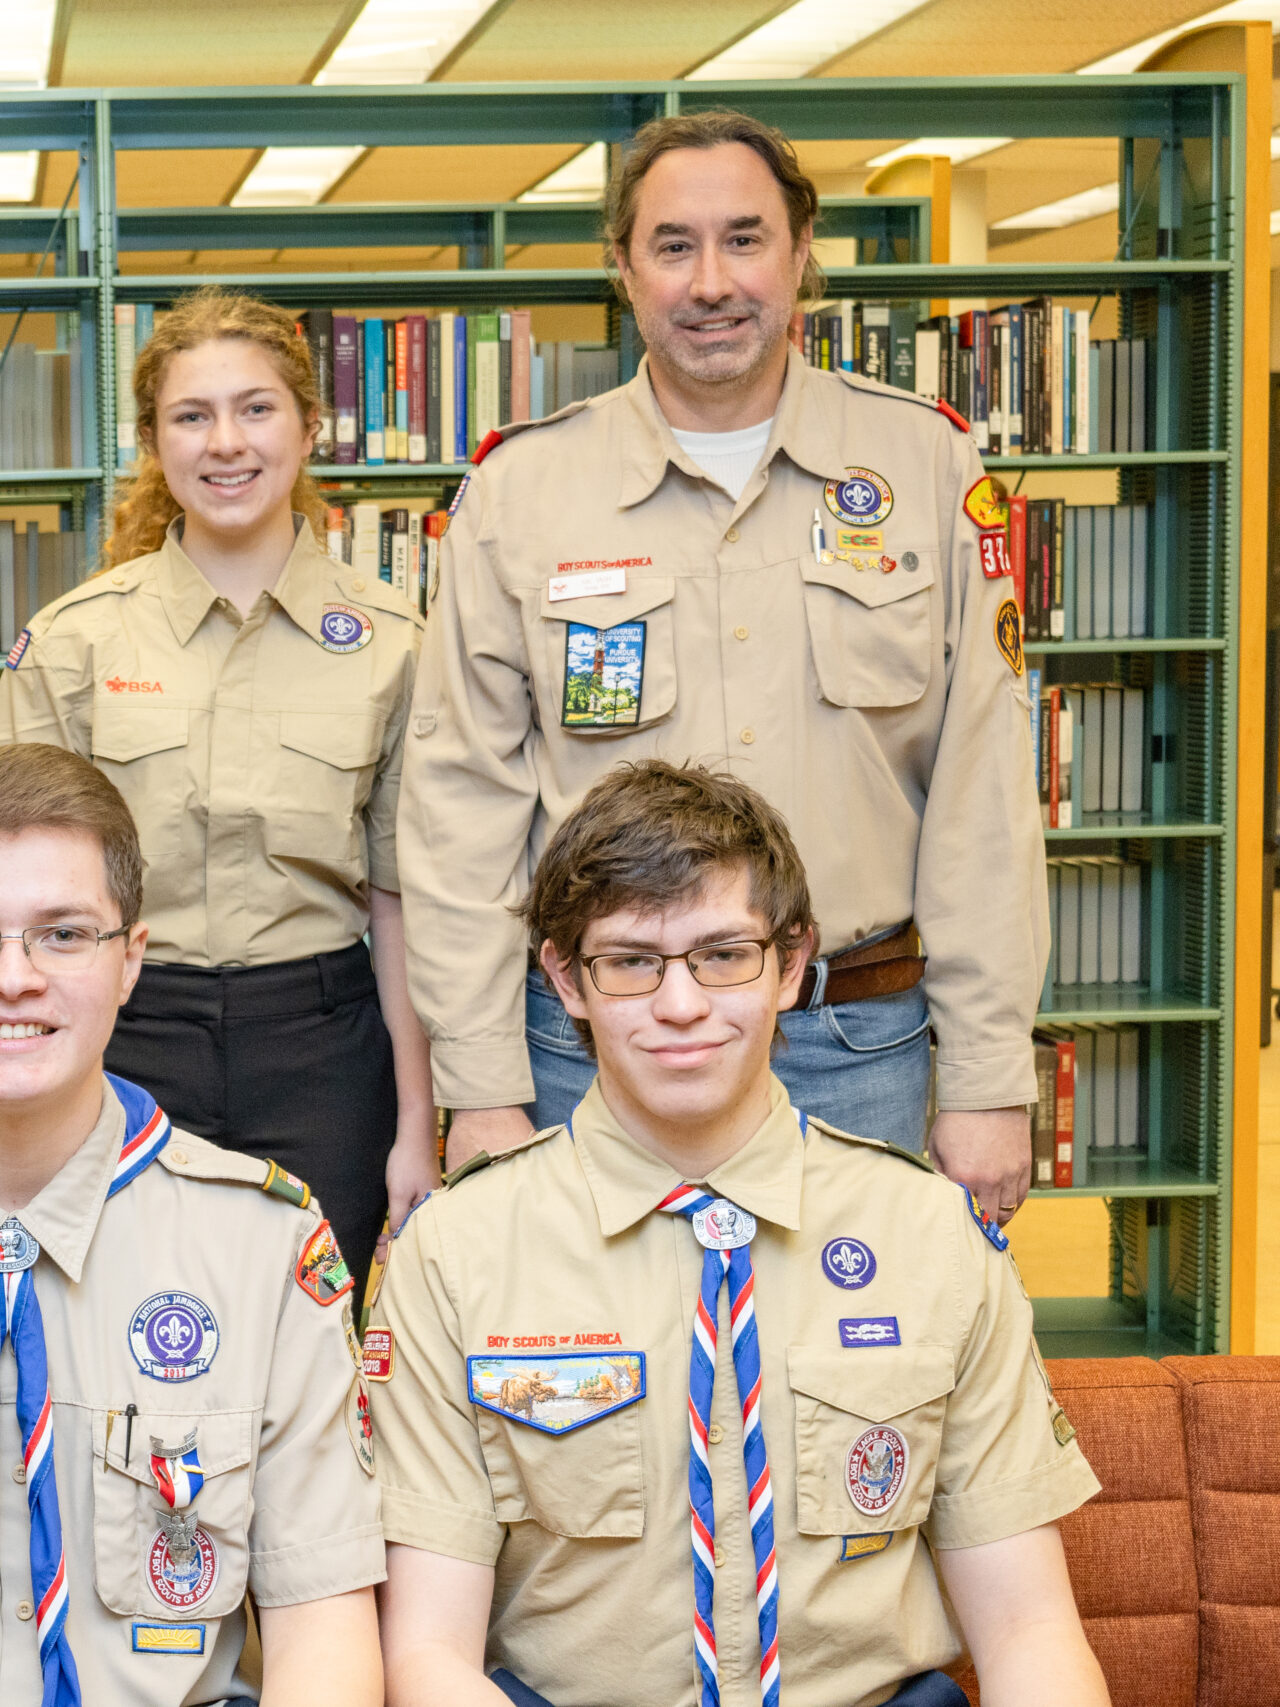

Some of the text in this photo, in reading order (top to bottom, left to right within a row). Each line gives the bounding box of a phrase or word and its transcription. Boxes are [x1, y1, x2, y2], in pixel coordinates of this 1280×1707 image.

[558, 562, 573, 573] BOY
[574, 560, 606, 571] SCOUTS
[615, 557, 653, 569] AMERICA
[396, 576, 404, 591] ME
[610, 649, 636, 657] PURDUE
[128, 682, 163, 694] BSA
[138, 1295, 207, 1321] NATIONAL JAMBOREE
[487, 1336, 510, 1348] BOY
[513, 1335, 556, 1348] SCOUTS
[573, 1332, 623, 1346] AMERICA
[163, 1367, 186, 1378] 2017
[857, 1431, 902, 1452] EAGLE SCOUT
[850, 1463, 858, 1480] BOY
[885, 1464, 903, 1502] AMERICA
[851, 1483, 873, 1508] SCOUTS
[874, 1499, 884, 1508] OF
[194, 1530, 208, 1547] OUT
[152, 1558, 213, 1604] BOY SCOUTS OF AMERICA
